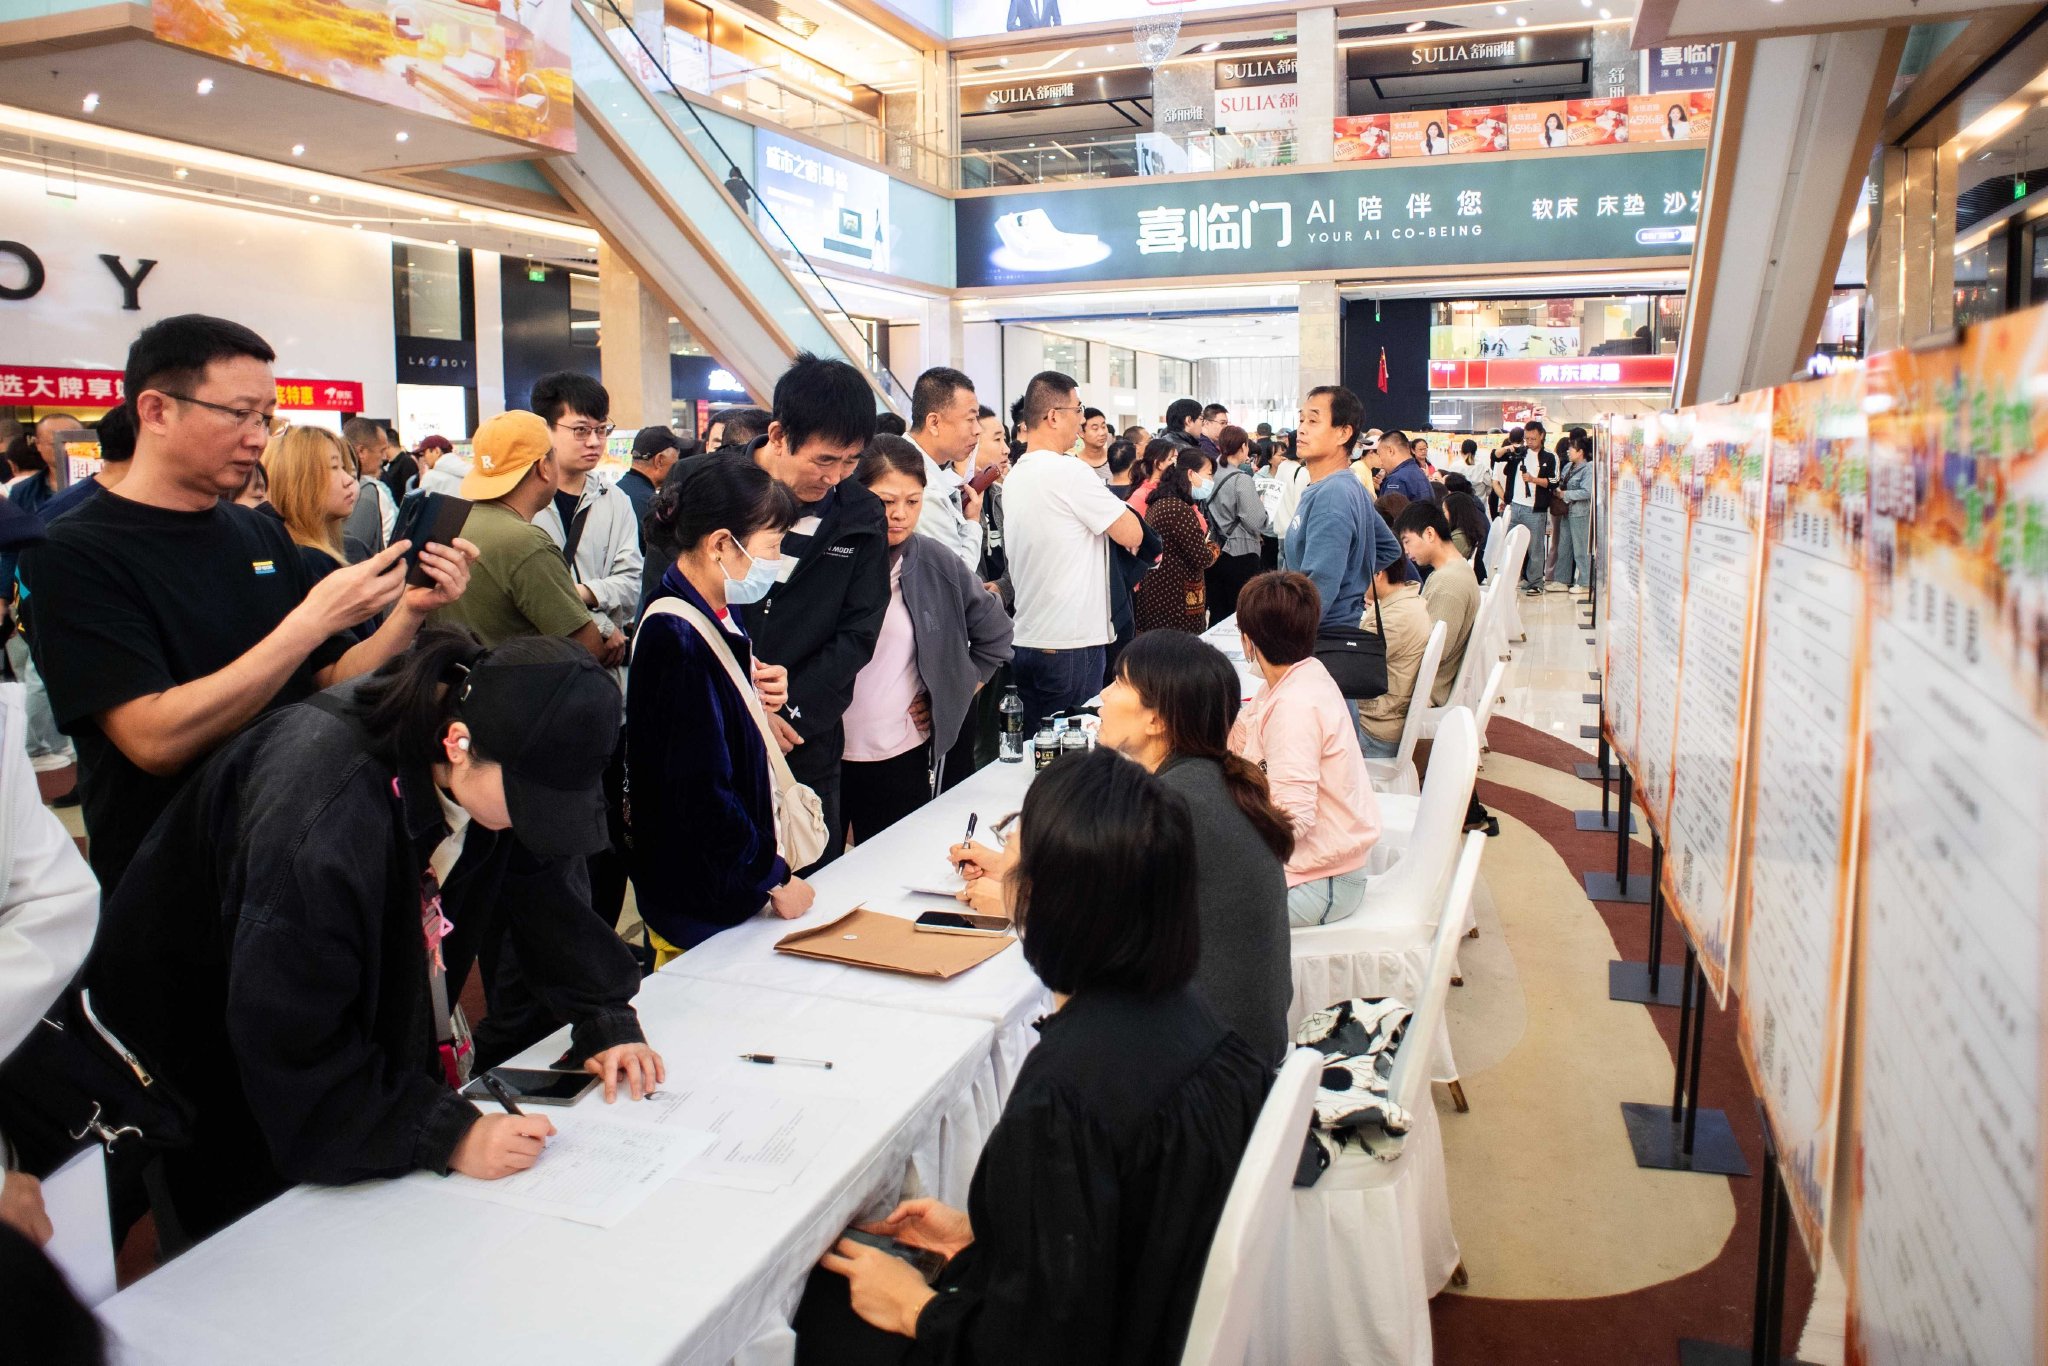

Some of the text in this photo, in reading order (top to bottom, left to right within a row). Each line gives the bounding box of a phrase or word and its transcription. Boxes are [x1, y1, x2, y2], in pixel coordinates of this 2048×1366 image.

[1412, 40, 1516, 66] SULIA 舒丽雅
[1224, 61, 1277, 80] SULIA
[989, 83, 1075, 105] SULIA 舒丽雅
[1220, 94, 1276, 114] SULIA
[1164, 106, 1204, 123] 舒丽雅
[1306, 190, 1483, 225] AI 陪伴您
[1532, 198, 1579, 220] 软床
[1596, 193, 1645, 216] 床垫
[1136, 200, 1293, 255] 喜临门
[1308, 225, 1483, 244] YOUR AI CO-BEING
[481, 455, 494, 469] R
